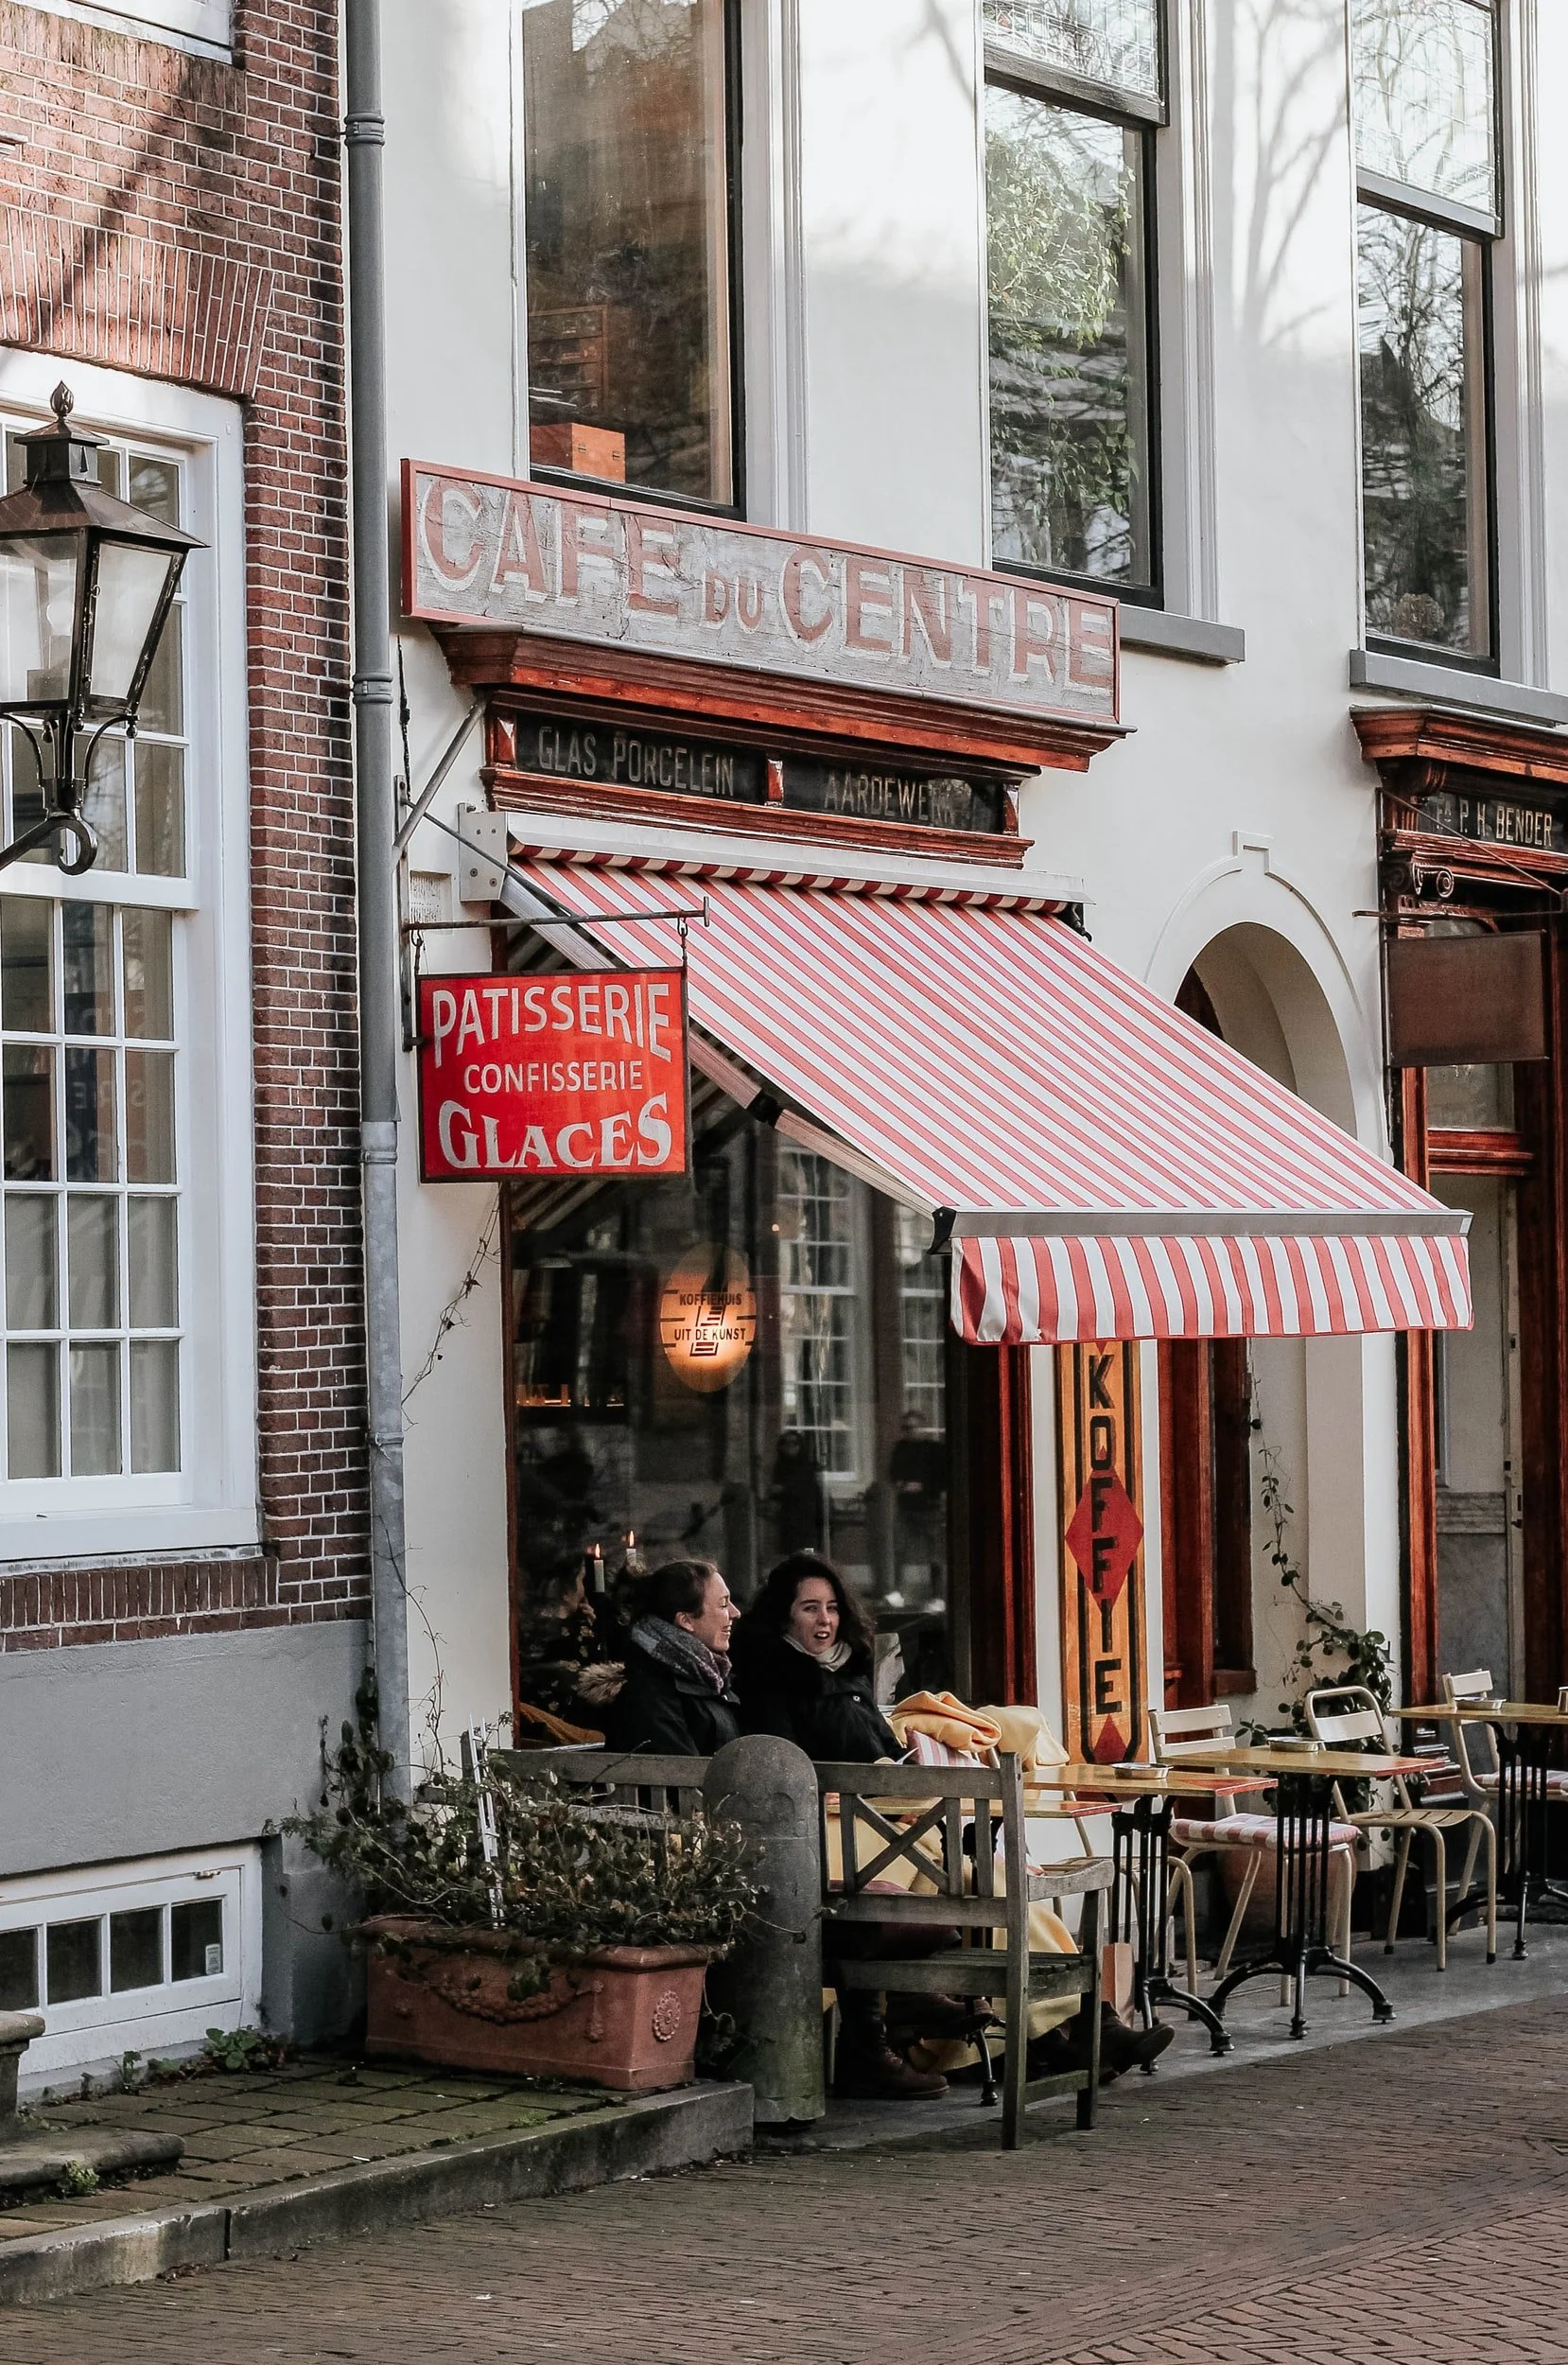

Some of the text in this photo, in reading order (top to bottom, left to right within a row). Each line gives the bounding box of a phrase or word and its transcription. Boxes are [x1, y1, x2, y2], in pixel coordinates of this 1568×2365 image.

[702, 568, 763, 632] DU
[780, 548, 1113, 693] CENTRE
[538, 726, 734, 797] GLAS PORCELEIN
[1496, 805, 1552, 847] BENDER
[432, 984, 671, 1068] PATISSERIE
[464, 1060, 642, 1094] CONFISSERIE
[438, 1093, 672, 1168] GLACES
[674, 1328, 746, 1340] UIT DE KUNST
[679, 1292, 742, 1305] KOFFIEHUIS
[1089, 1355, 1123, 1715] KOFFIE
